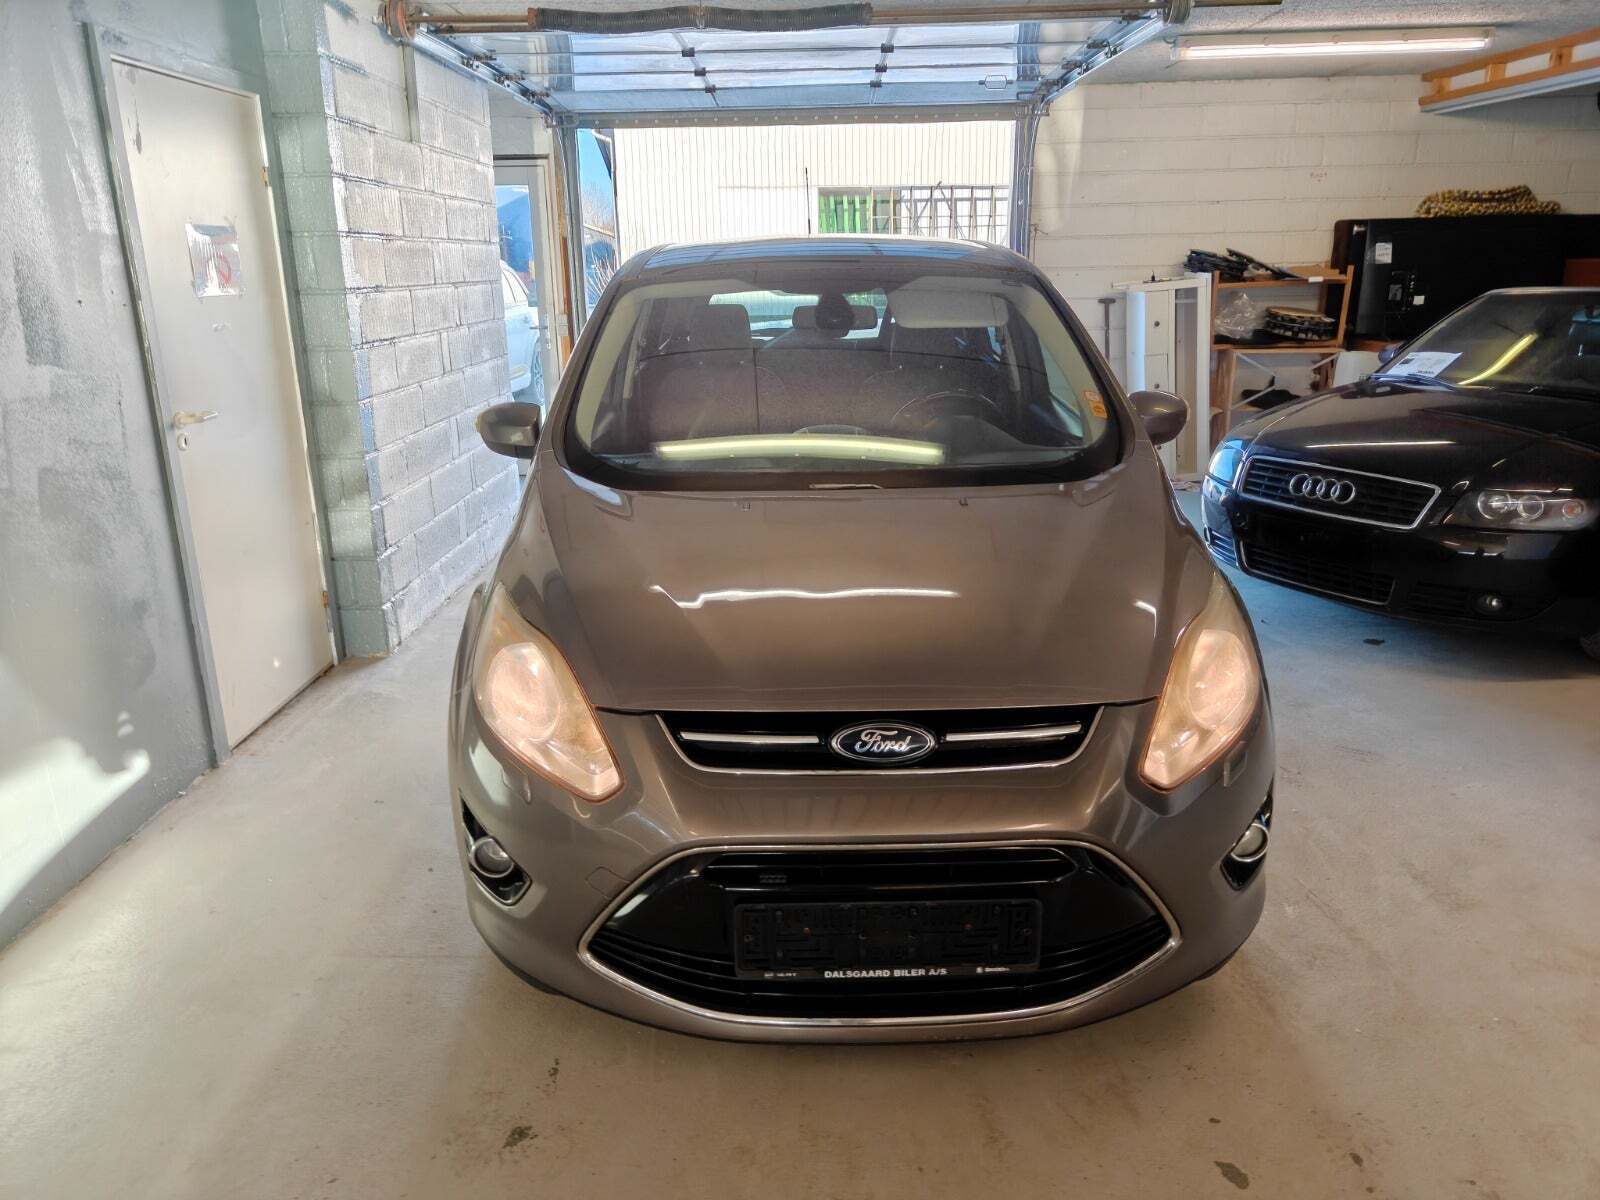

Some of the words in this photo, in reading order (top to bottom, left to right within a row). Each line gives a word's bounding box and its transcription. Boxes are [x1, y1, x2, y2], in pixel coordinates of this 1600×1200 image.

[854, 729, 919, 753] Ford
[824, 970, 890, 978] DALSGAARD
[894, 969, 926, 977] BILER
[928, 968, 948, 976] A/S
